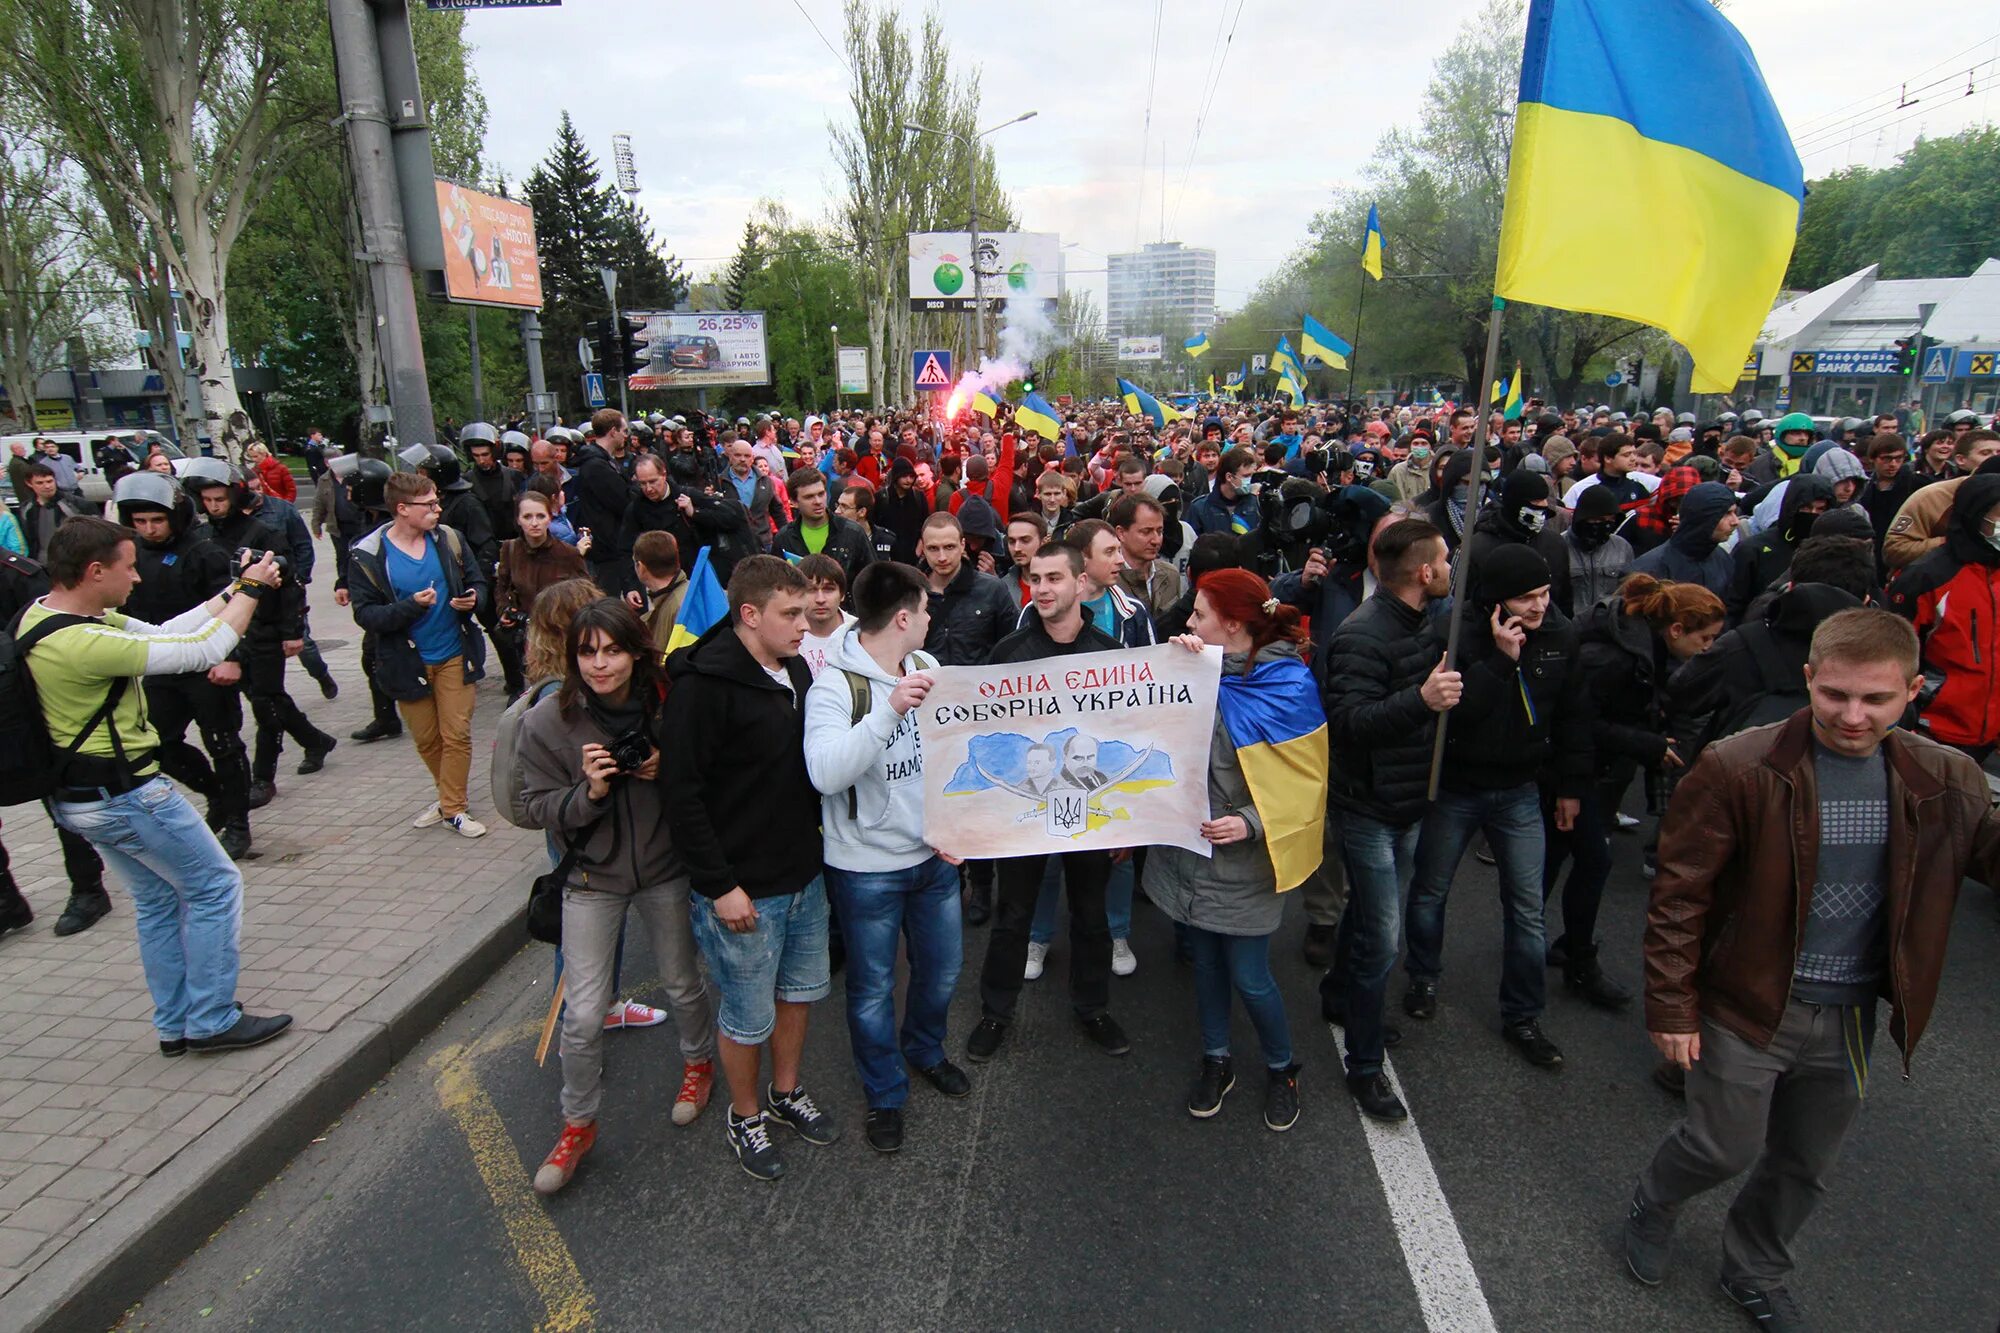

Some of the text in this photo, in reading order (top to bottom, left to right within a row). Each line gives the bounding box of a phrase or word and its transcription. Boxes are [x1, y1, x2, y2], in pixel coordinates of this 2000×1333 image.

[698, 317, 758, 332] 26,25%
[1816, 362, 1854, 373] БАНК
[979, 662, 1154, 699] ОДНА ЄДИНА
[935, 683, 1193, 725] СОБОРНА УКРАЇНА
